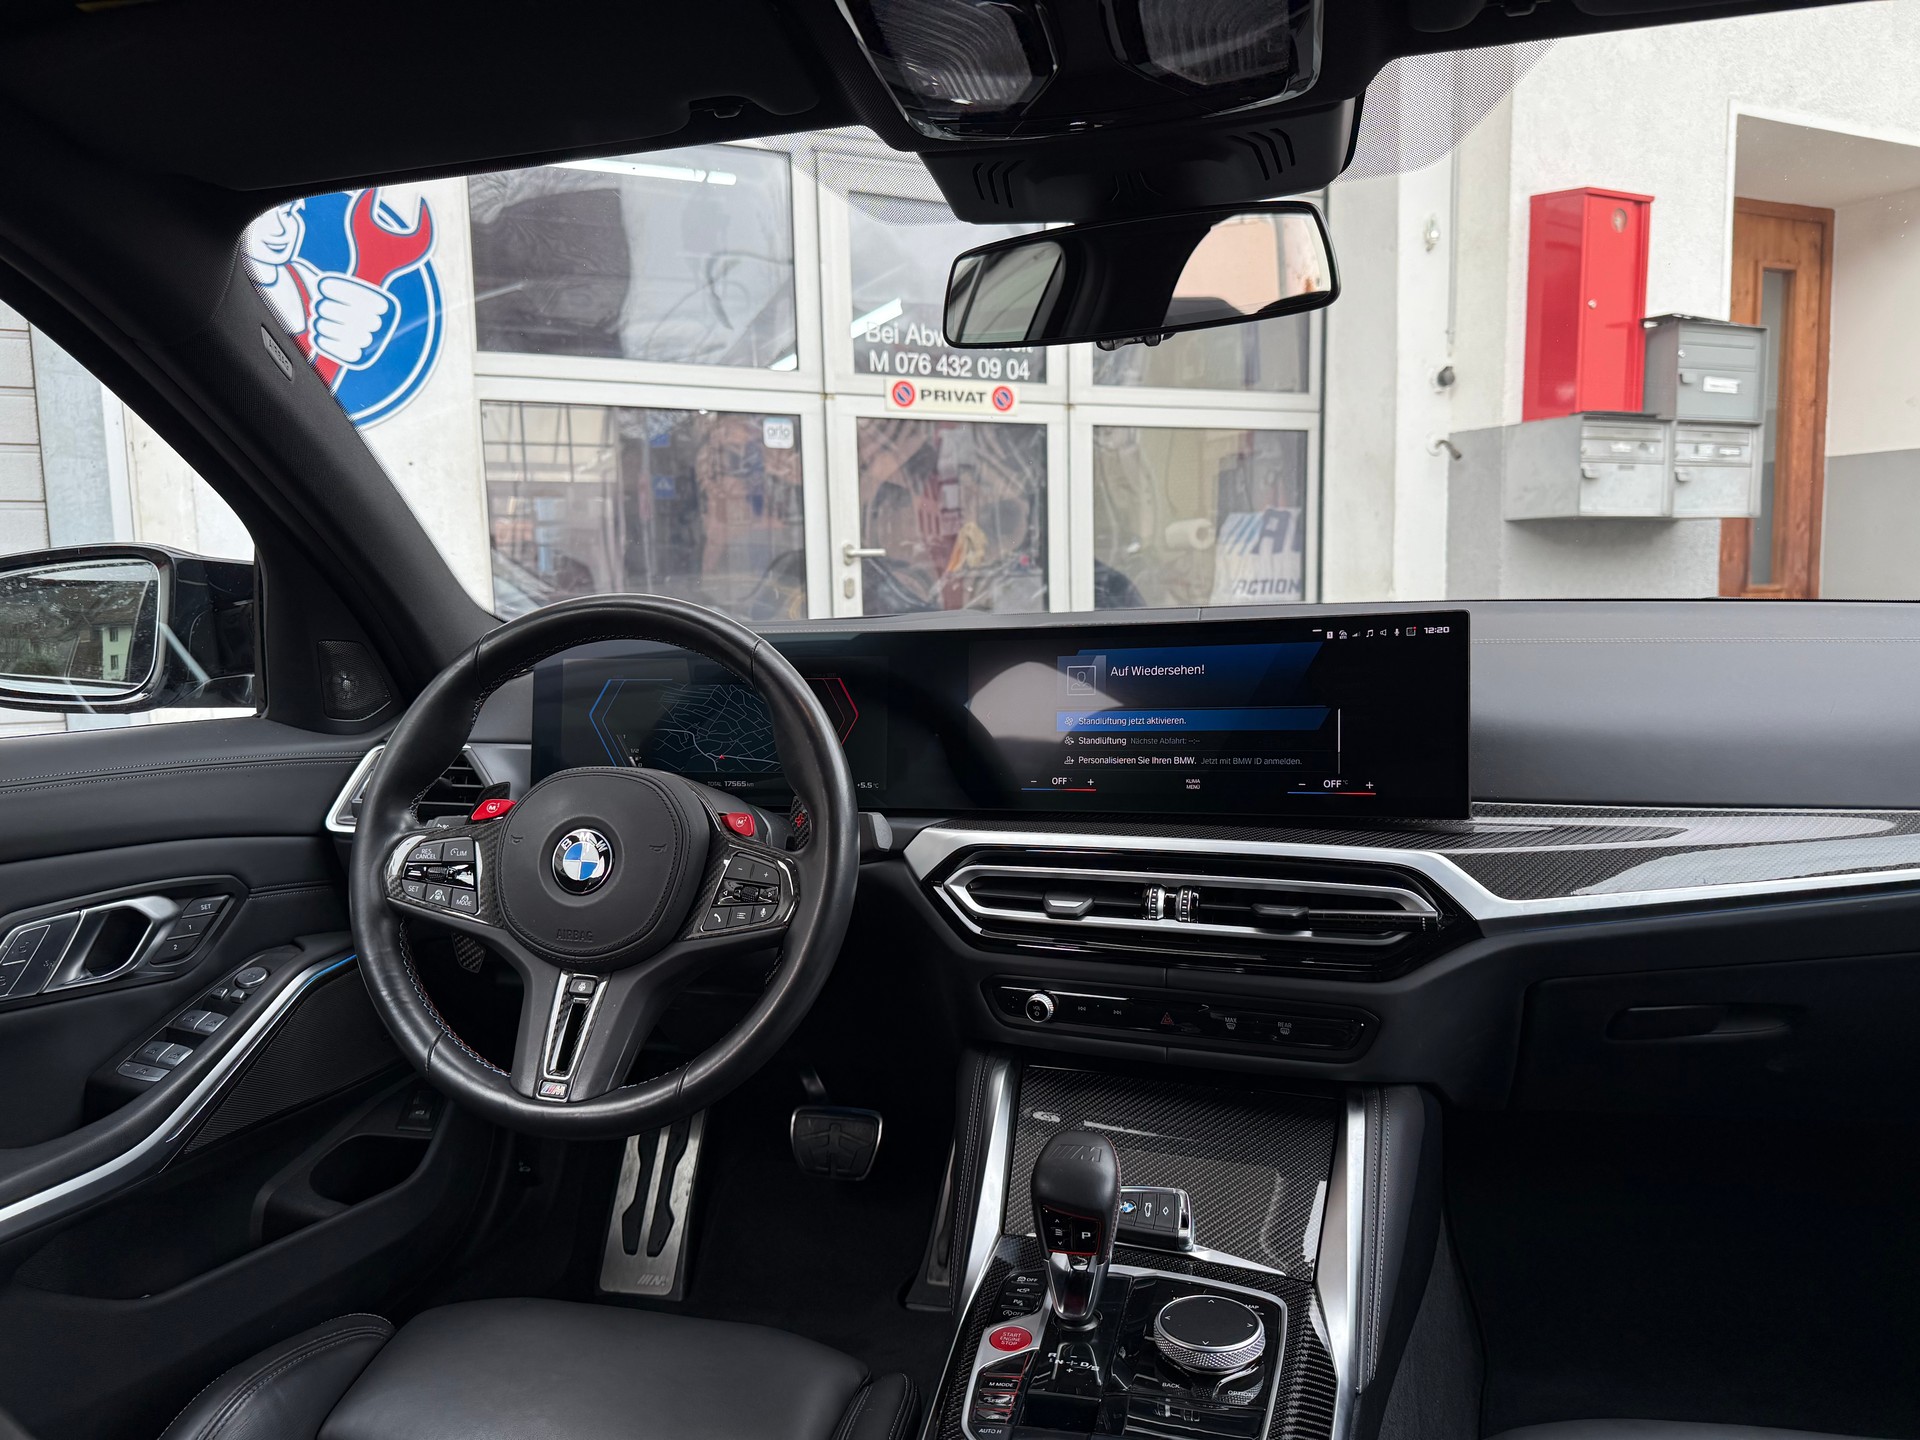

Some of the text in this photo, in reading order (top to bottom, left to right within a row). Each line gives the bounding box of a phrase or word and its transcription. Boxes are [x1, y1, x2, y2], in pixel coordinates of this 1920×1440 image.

[865, 322, 900, 343] Bei
[869, 351, 1031, 380] M 076 432 09 04
[920, 389, 987, 403] PRIVAT
[1233, 579, 1301, 595] ACTION
[1424, 626, 1450, 634] 12:20
[1110, 664, 1205, 677] Auf Wiedersehen!
[1078, 716, 1187, 726] Standlüftung jetzt aktivieren.
[1078, 737, 1127, 746] Standlüftung
[1131, 737, 1158, 745] Nächste
[1078, 756, 1136, 765] Personalisieren
[1138, 756, 1150, 765] Sie
[1152, 756, 1172, 765] Ihren
[1174, 756, 1197, 765] BMW.
[1264, 757, 1303, 765] anmelden.
[1051, 777, 1067, 785] OFF
[1323, 779, 1341, 788] OFF
[561, 831, 608, 853] BMW
[556, 928, 593, 942] AIRBAG
[1081, 1231, 1091, 1239] P
